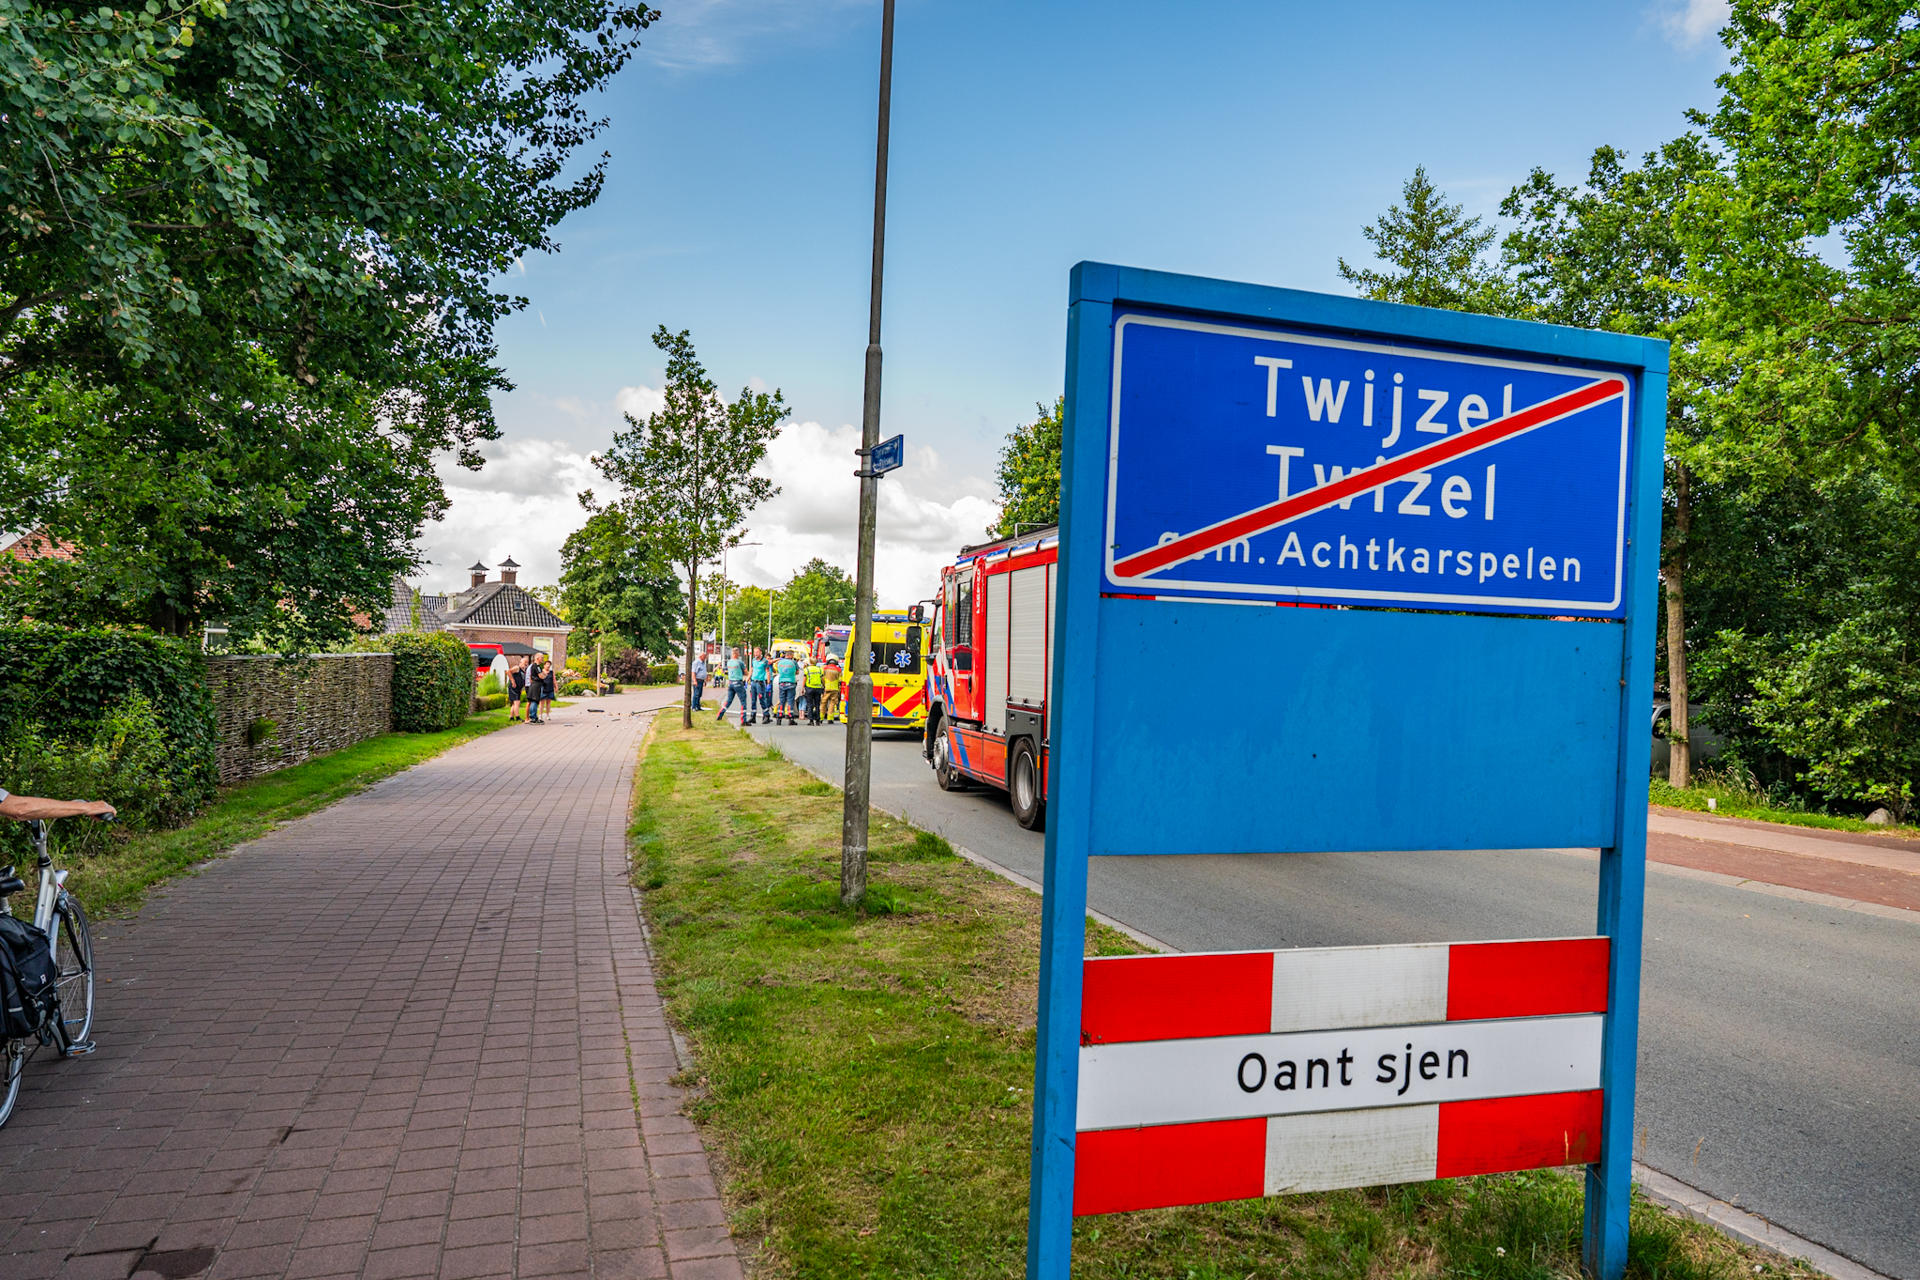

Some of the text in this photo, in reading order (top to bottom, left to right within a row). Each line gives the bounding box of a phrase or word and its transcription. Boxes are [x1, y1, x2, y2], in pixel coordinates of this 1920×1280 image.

[1254, 355, 1513, 449] Twijzel
[1265, 444, 1497, 521] Twizel
[1157, 531, 1583, 583] m. Achtkarspelen
[1237, 1042, 1470, 1096] Oant sjen
